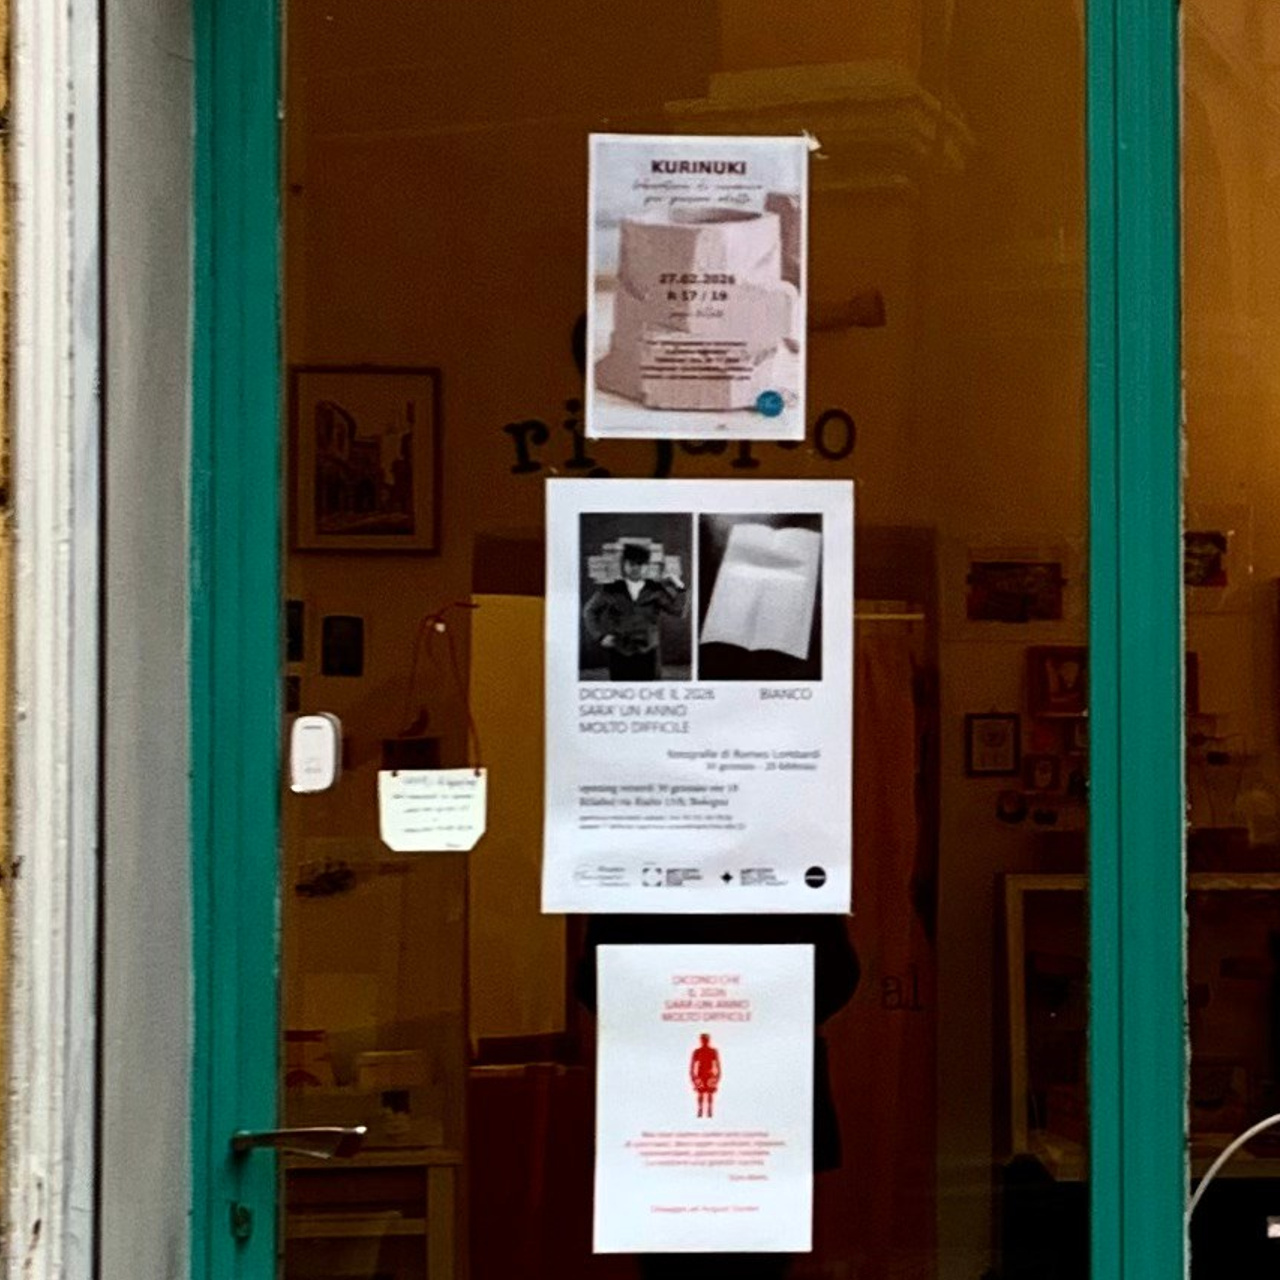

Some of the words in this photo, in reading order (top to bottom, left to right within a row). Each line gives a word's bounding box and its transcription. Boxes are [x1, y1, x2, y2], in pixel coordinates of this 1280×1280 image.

[651, 160, 747, 175] KURINUKI
[578, 688, 635, 701] DICONO
[638, 688, 666, 701] CHE
[759, 688, 813, 701] BIANCO
[619, 704, 641, 717] UN
[645, 704, 688, 717] ANNO
[578, 721, 627, 734] MOLTO
[630, 721, 690, 734] DIFFICILE
